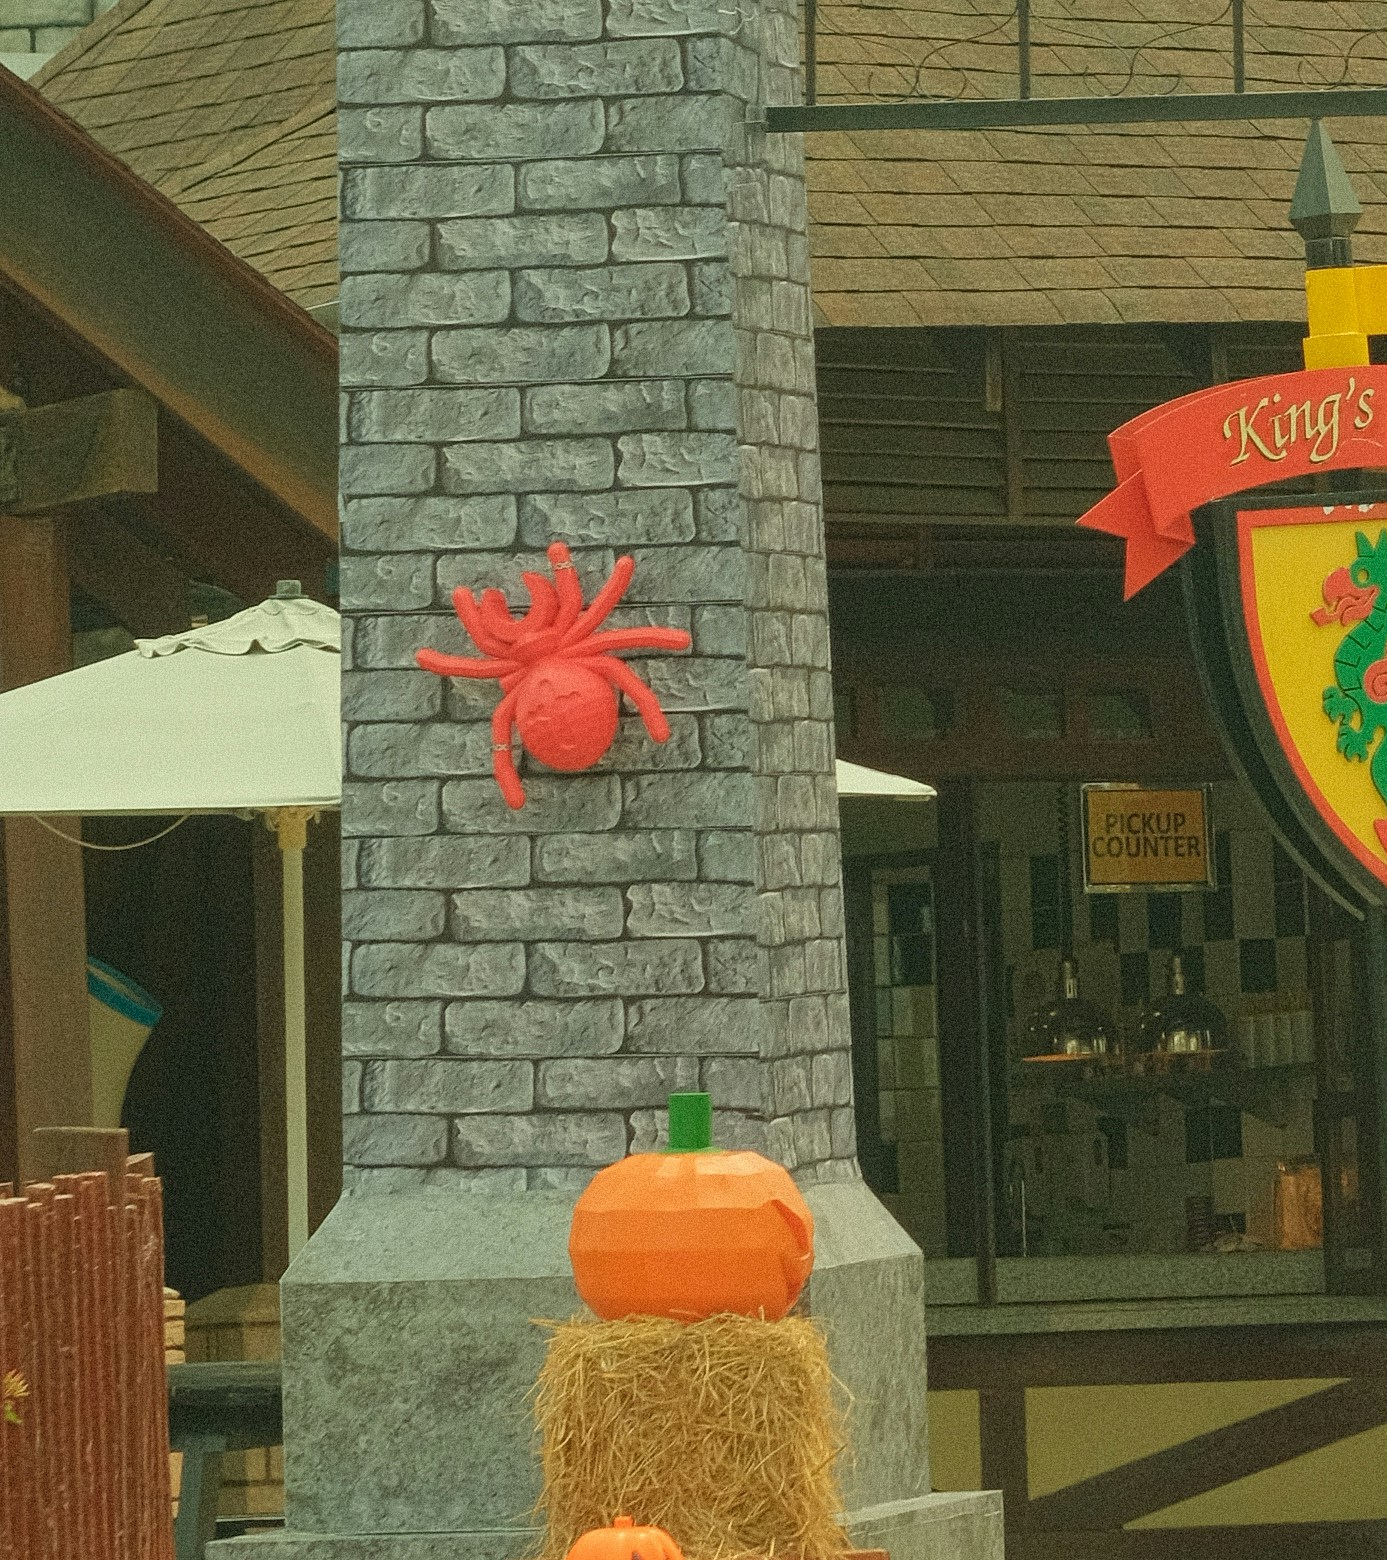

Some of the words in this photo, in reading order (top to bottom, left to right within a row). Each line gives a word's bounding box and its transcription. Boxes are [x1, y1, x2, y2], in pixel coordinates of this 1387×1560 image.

[1222, 376, 1376, 467] King's
[1104, 811, 1186, 835] PICKUP
[1091, 835, 1201, 858] COUNTER
